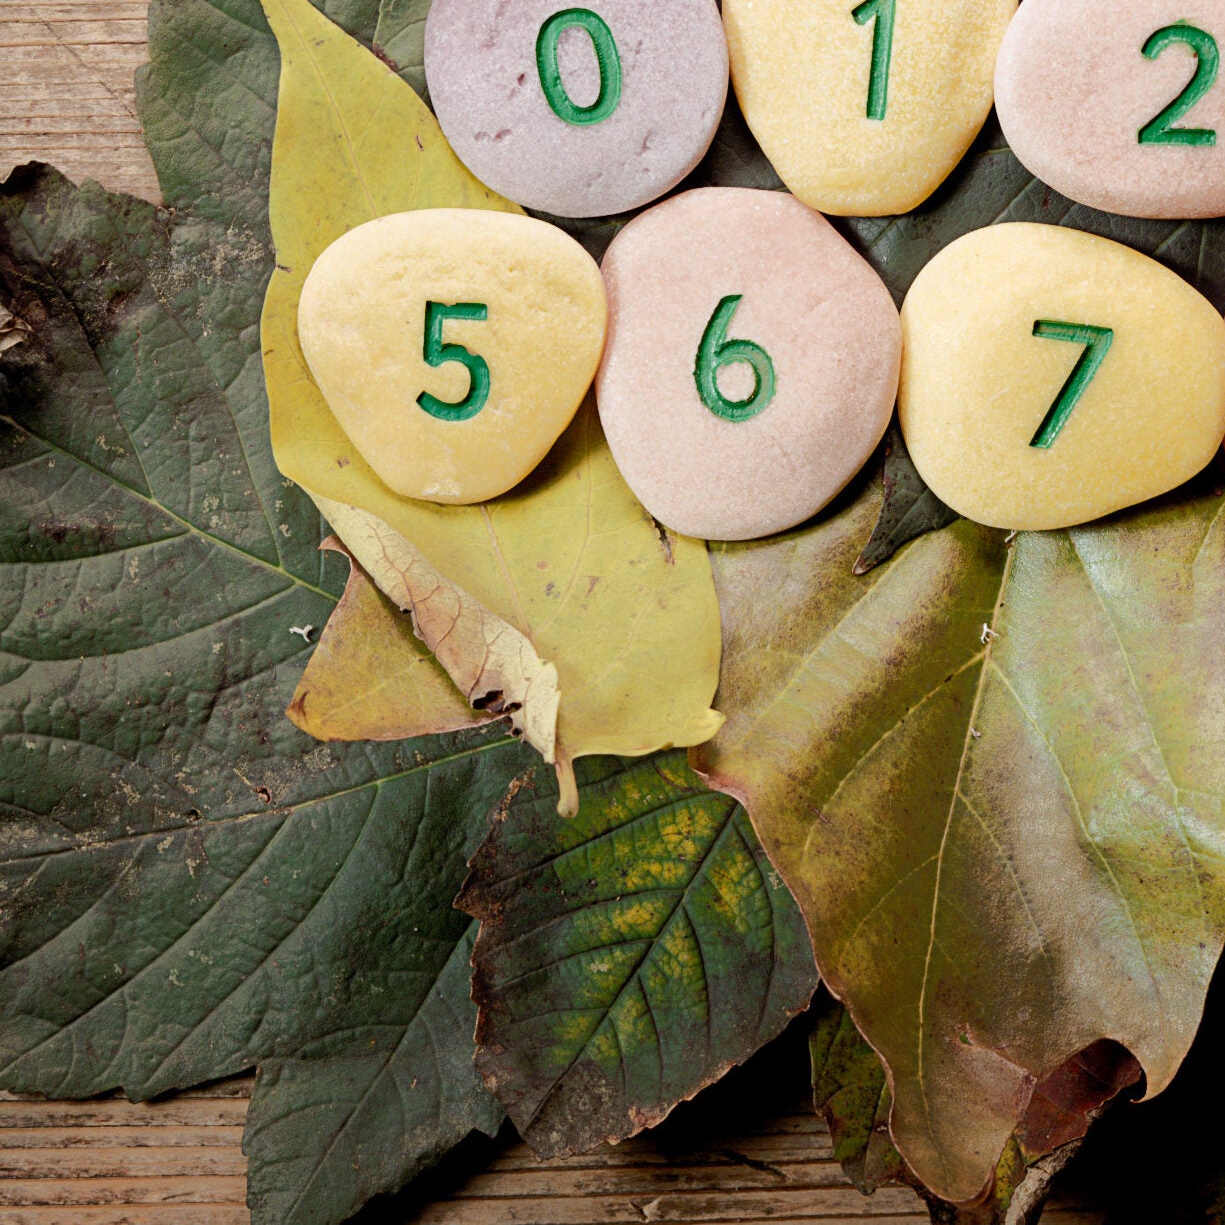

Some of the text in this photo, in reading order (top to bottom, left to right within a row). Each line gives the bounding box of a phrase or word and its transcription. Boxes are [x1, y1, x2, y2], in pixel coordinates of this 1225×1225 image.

[535, 7, 622, 126] 0
[1139, 21, 1220, 147] 2
[417, 301, 492, 422] 5
[694, 294, 775, 422] 6
[1031, 322, 1114, 449] 7
